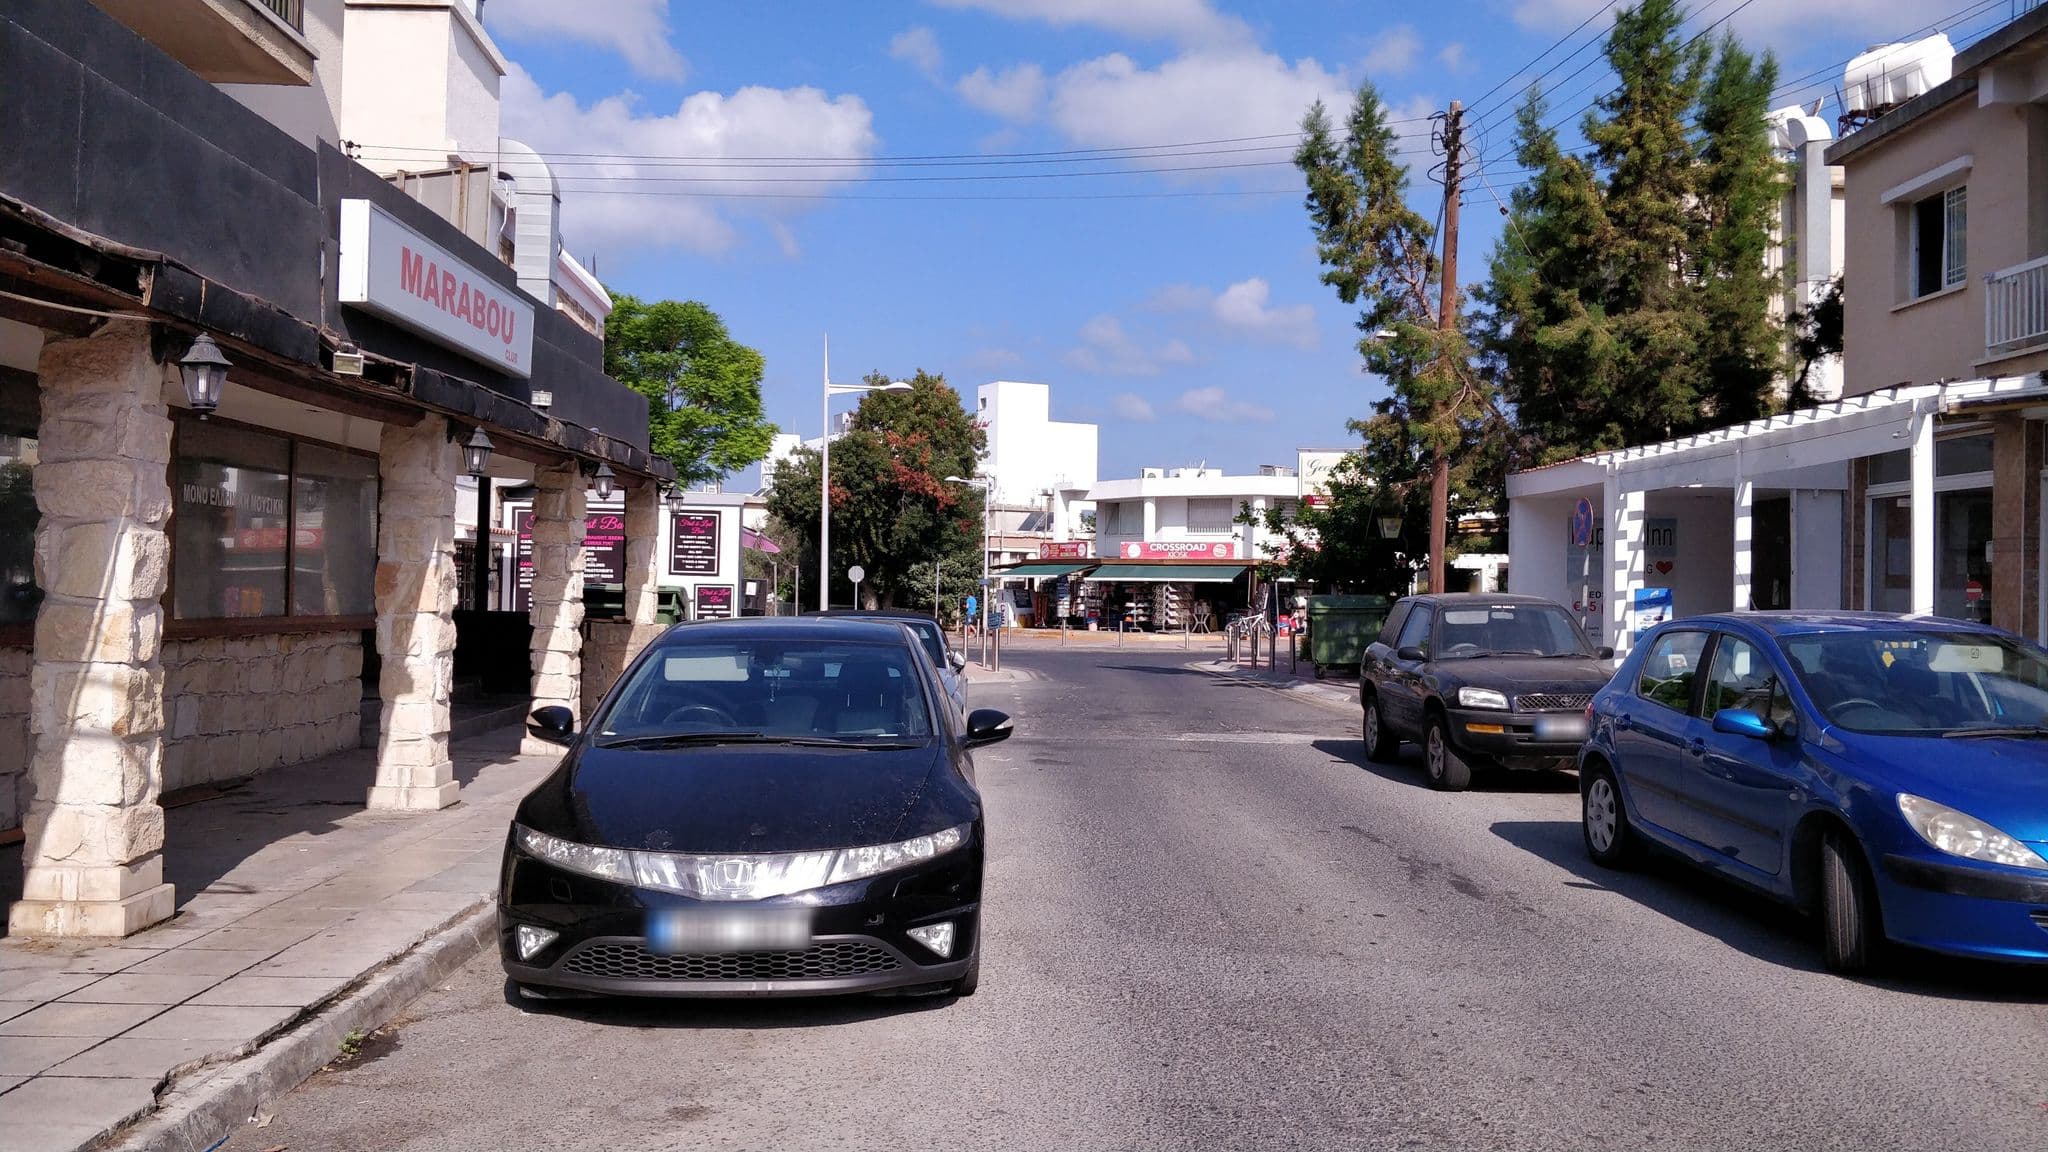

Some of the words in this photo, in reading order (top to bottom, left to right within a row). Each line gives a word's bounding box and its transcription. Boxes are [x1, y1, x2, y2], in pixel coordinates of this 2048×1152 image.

[400, 246, 515, 345] MARABOU
[183, 483, 208, 505] ΜΟΝΟ
[1149, 543, 1207, 552] CROSSROAD
